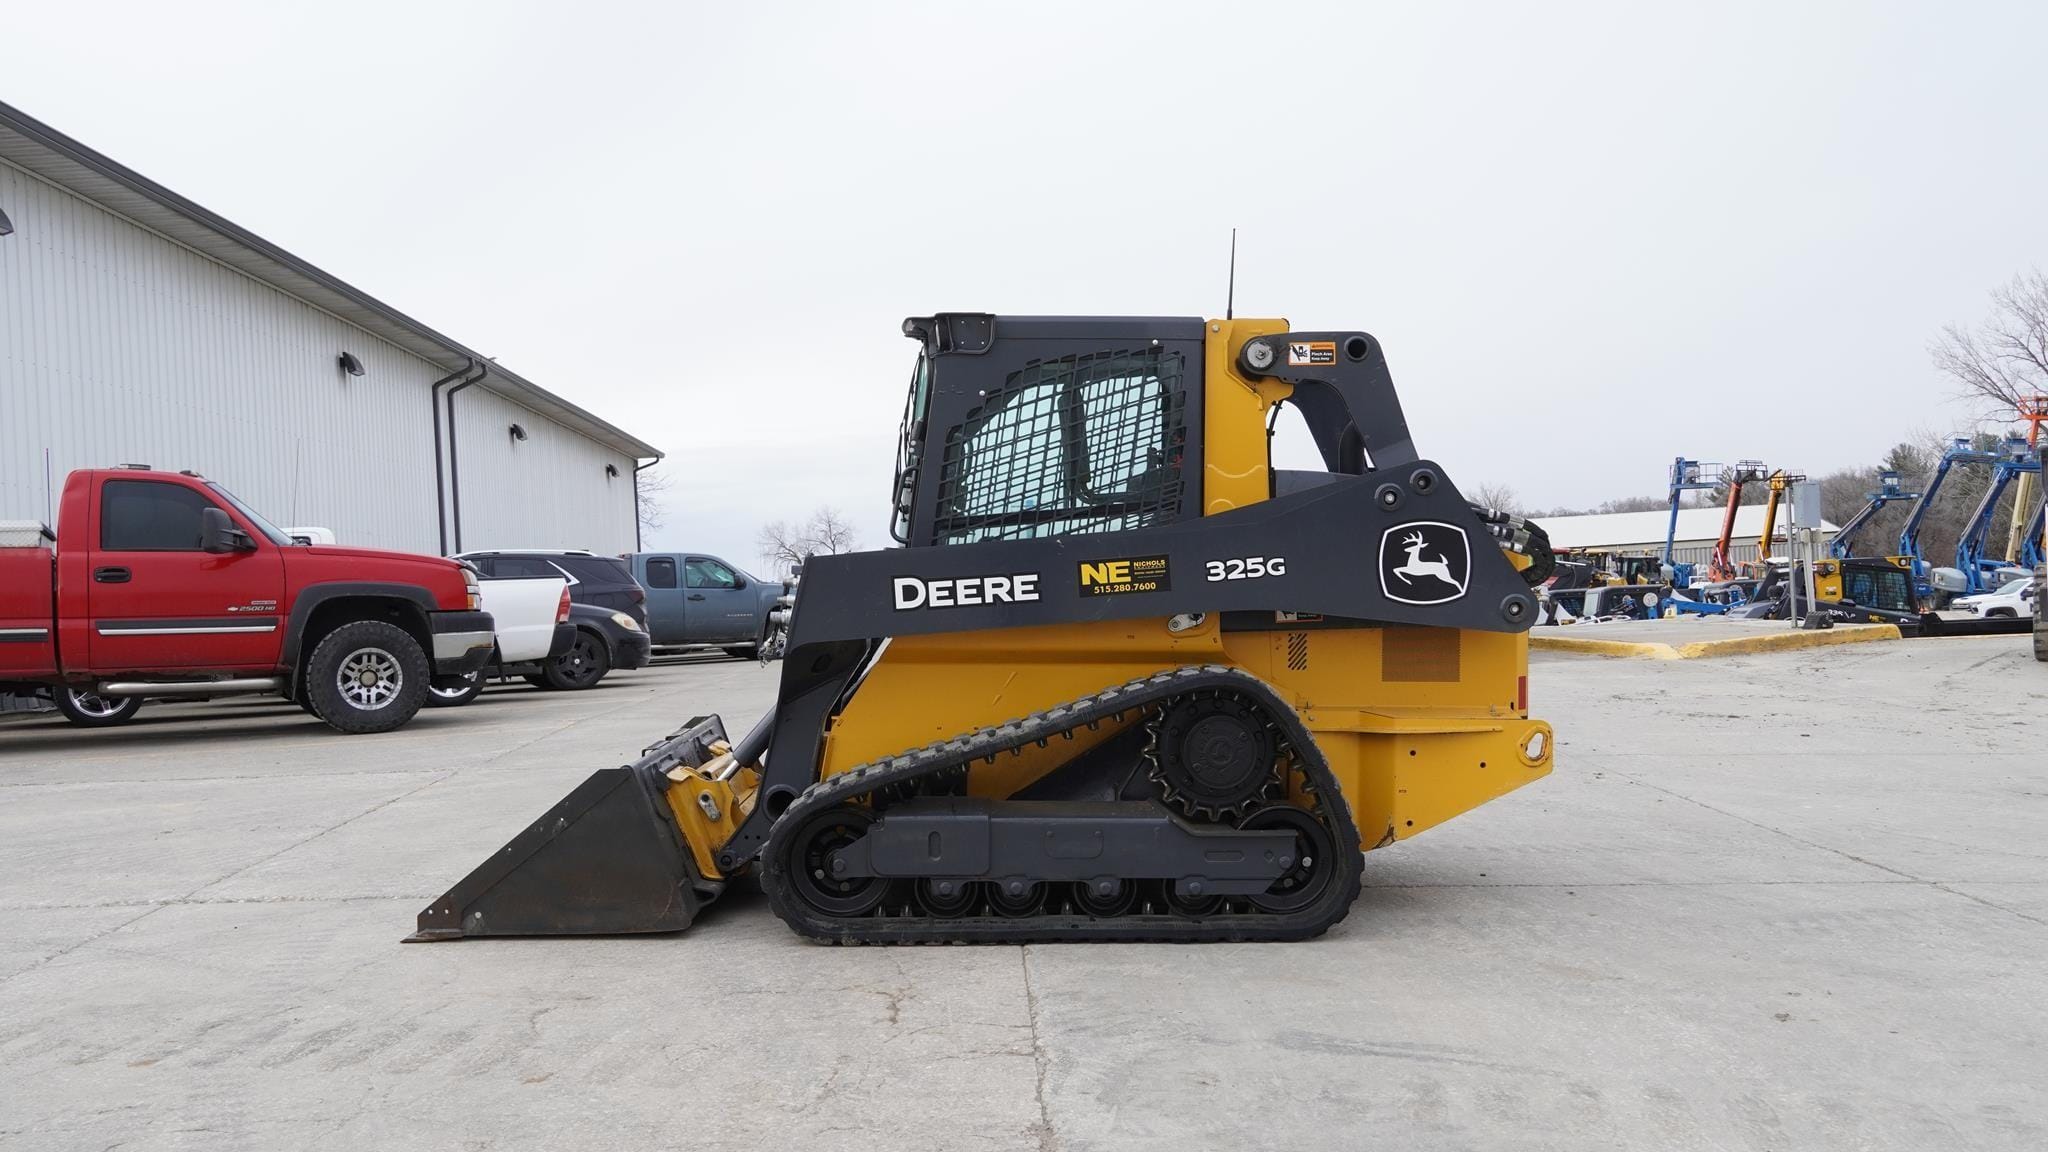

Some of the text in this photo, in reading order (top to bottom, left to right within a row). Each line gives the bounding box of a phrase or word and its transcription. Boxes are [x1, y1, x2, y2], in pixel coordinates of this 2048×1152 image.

[1080, 560, 1132, 586] NE
[1133, 559, 1166, 567] NICHOLS
[1206, 557, 1286, 582] 325G
[893, 573, 1040, 610] DEERE
[1093, 582, 1157, 594] 515.280.7600
